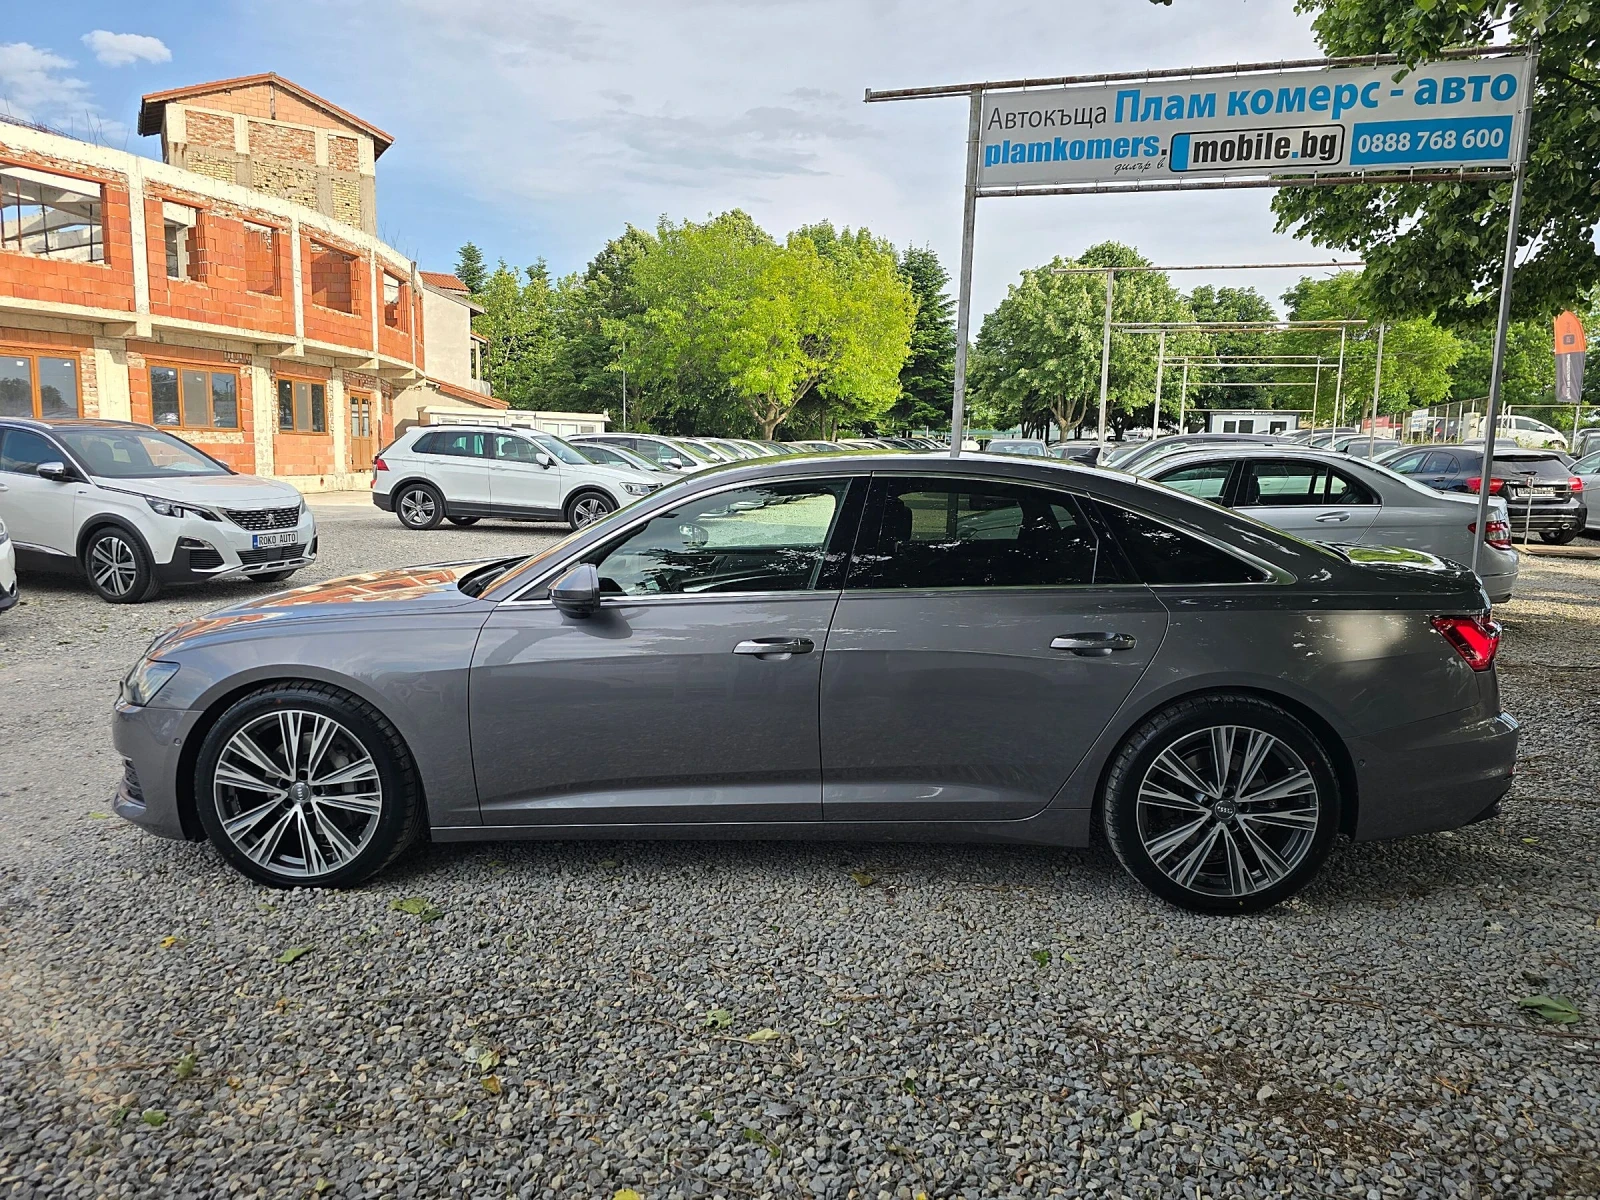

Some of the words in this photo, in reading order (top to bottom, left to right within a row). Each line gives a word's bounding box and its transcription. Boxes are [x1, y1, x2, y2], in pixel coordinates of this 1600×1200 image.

[987, 106, 1107, 131] Автокъща
[1114, 89, 1217, 123] Плам
[1227, 81, 1381, 120] комерс
[1414, 73, 1518, 106] авто
[1192, 130, 1338, 164] mobile.bg
[1357, 131, 1411, 154] 0888
[1416, 130, 1457, 150] 768
[1461, 128, 1505, 149] 600
[259, 535, 277, 546] ROKO
[280, 533, 296, 543] AUTO
